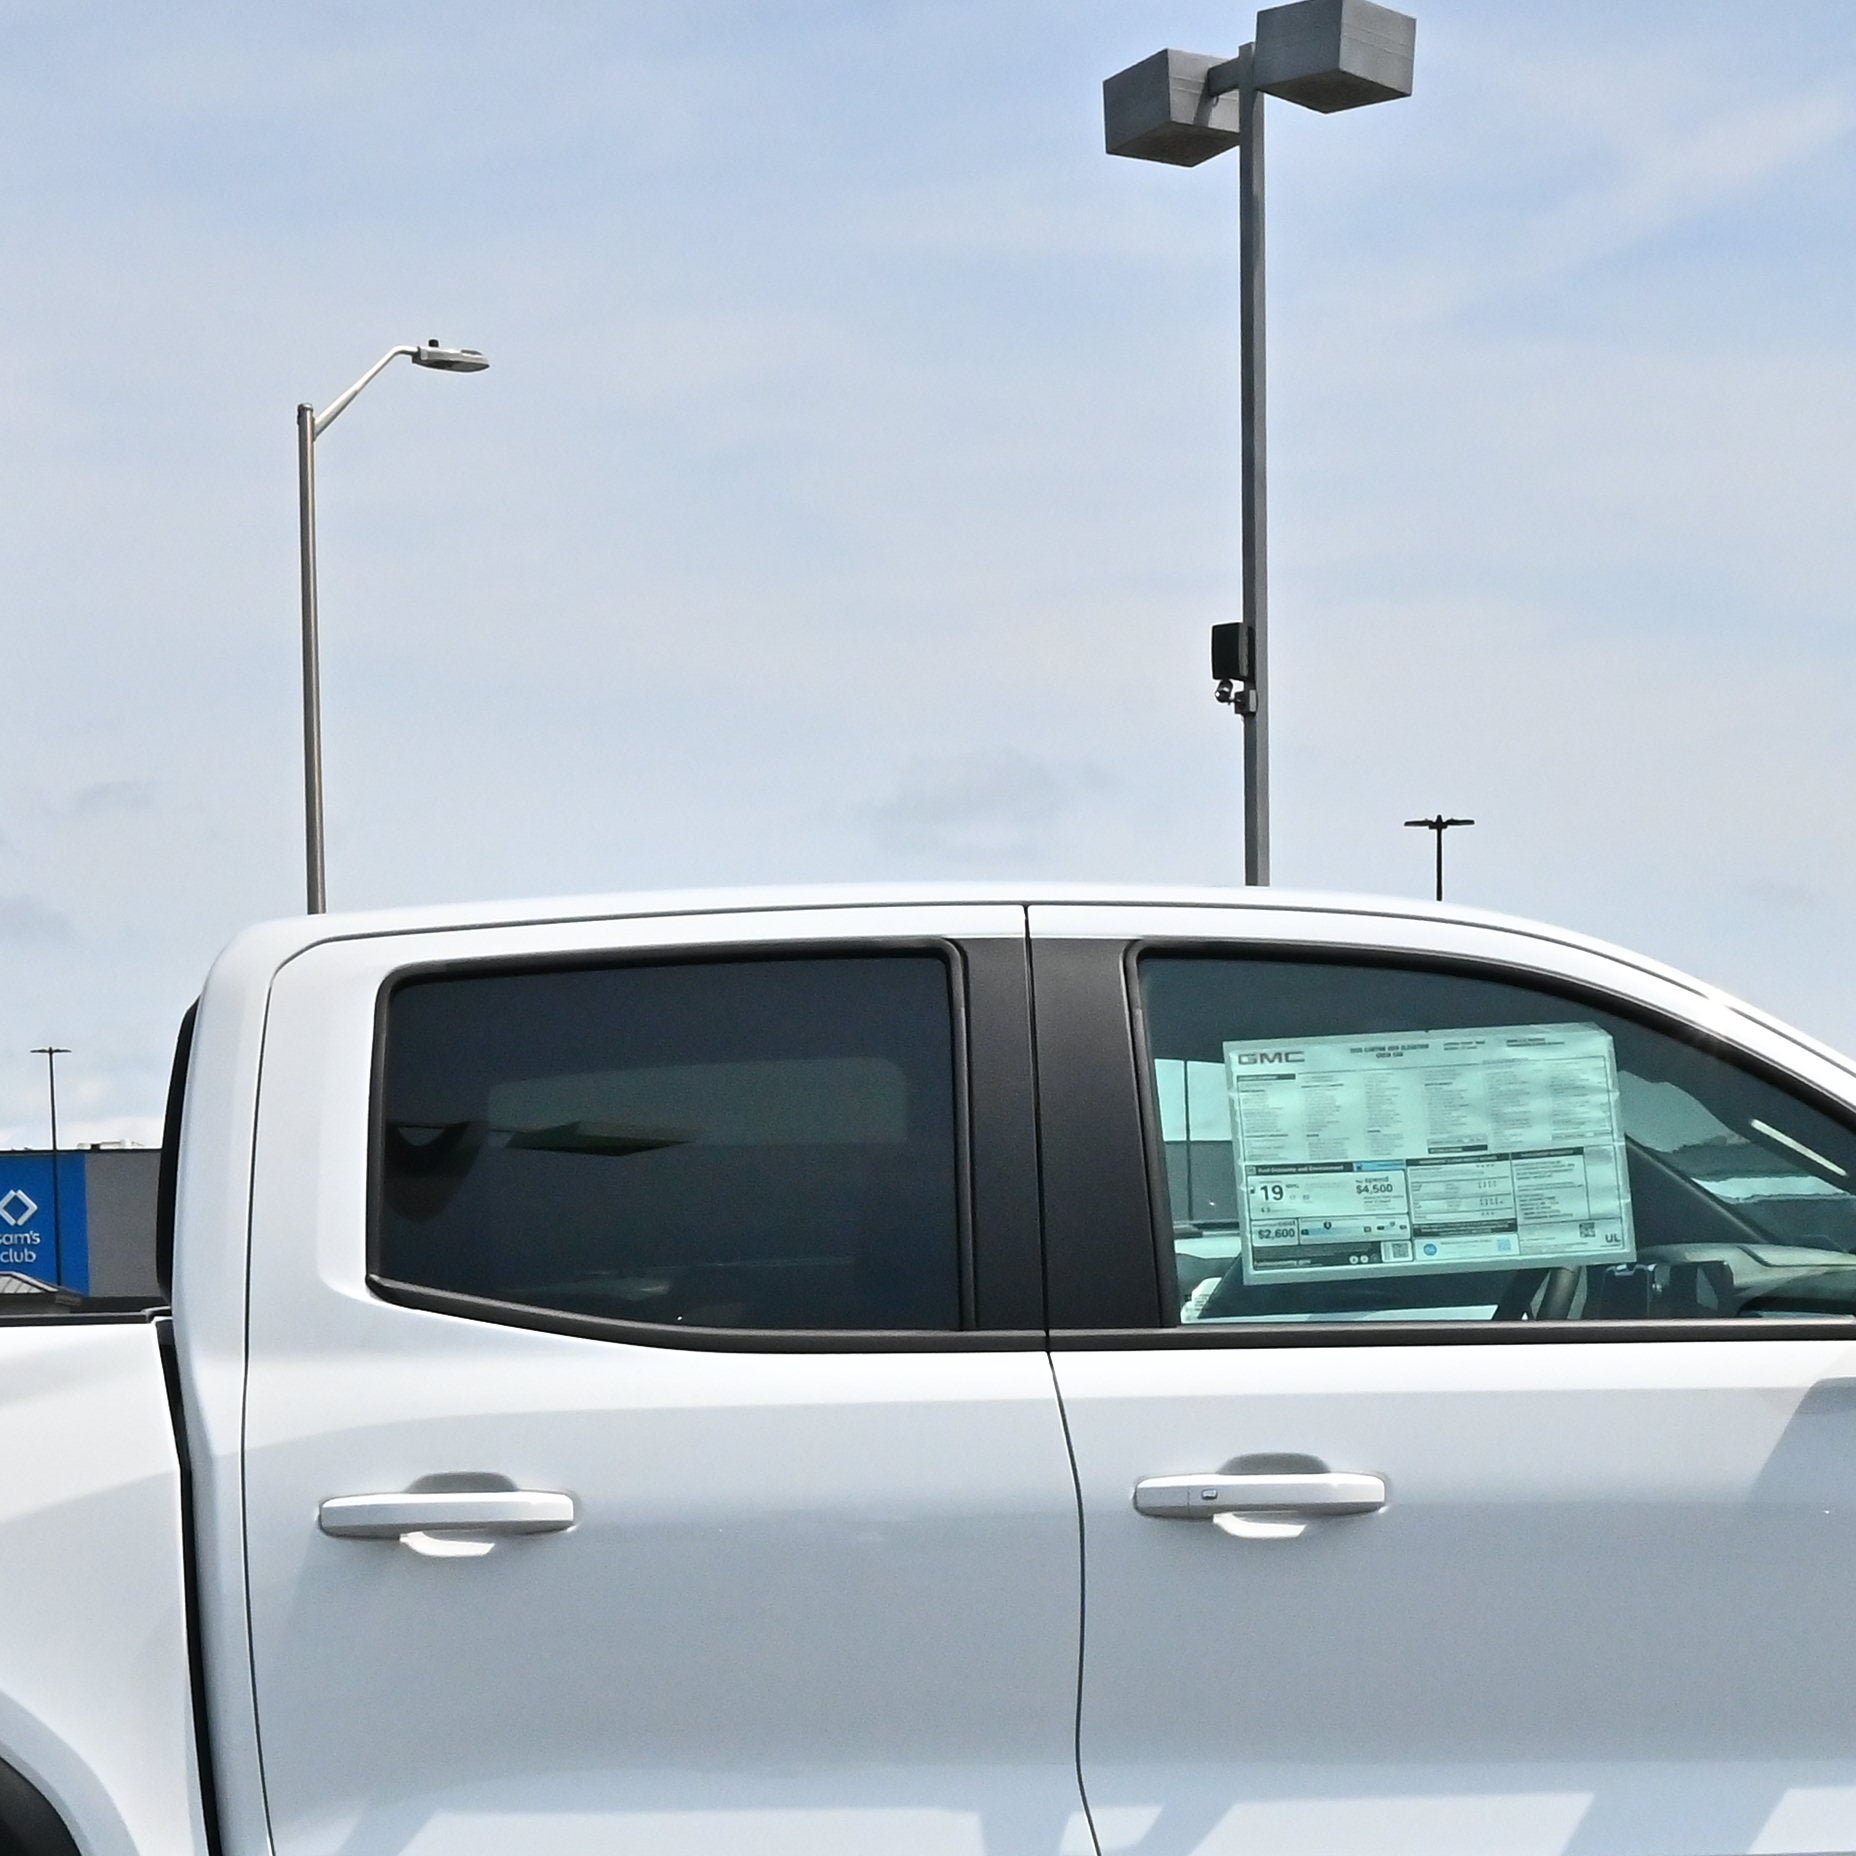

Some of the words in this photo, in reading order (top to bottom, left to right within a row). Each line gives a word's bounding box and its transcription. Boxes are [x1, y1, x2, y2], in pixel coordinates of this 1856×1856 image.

[1238, 1051, 1305, 1065] GMC
[1260, 1184, 1284, 1201] 19
[1355, 1183, 1394, 1195] $4,500
[1257, 1228, 1295, 1240] $2,600
[0, 1247, 36, 1263] club
